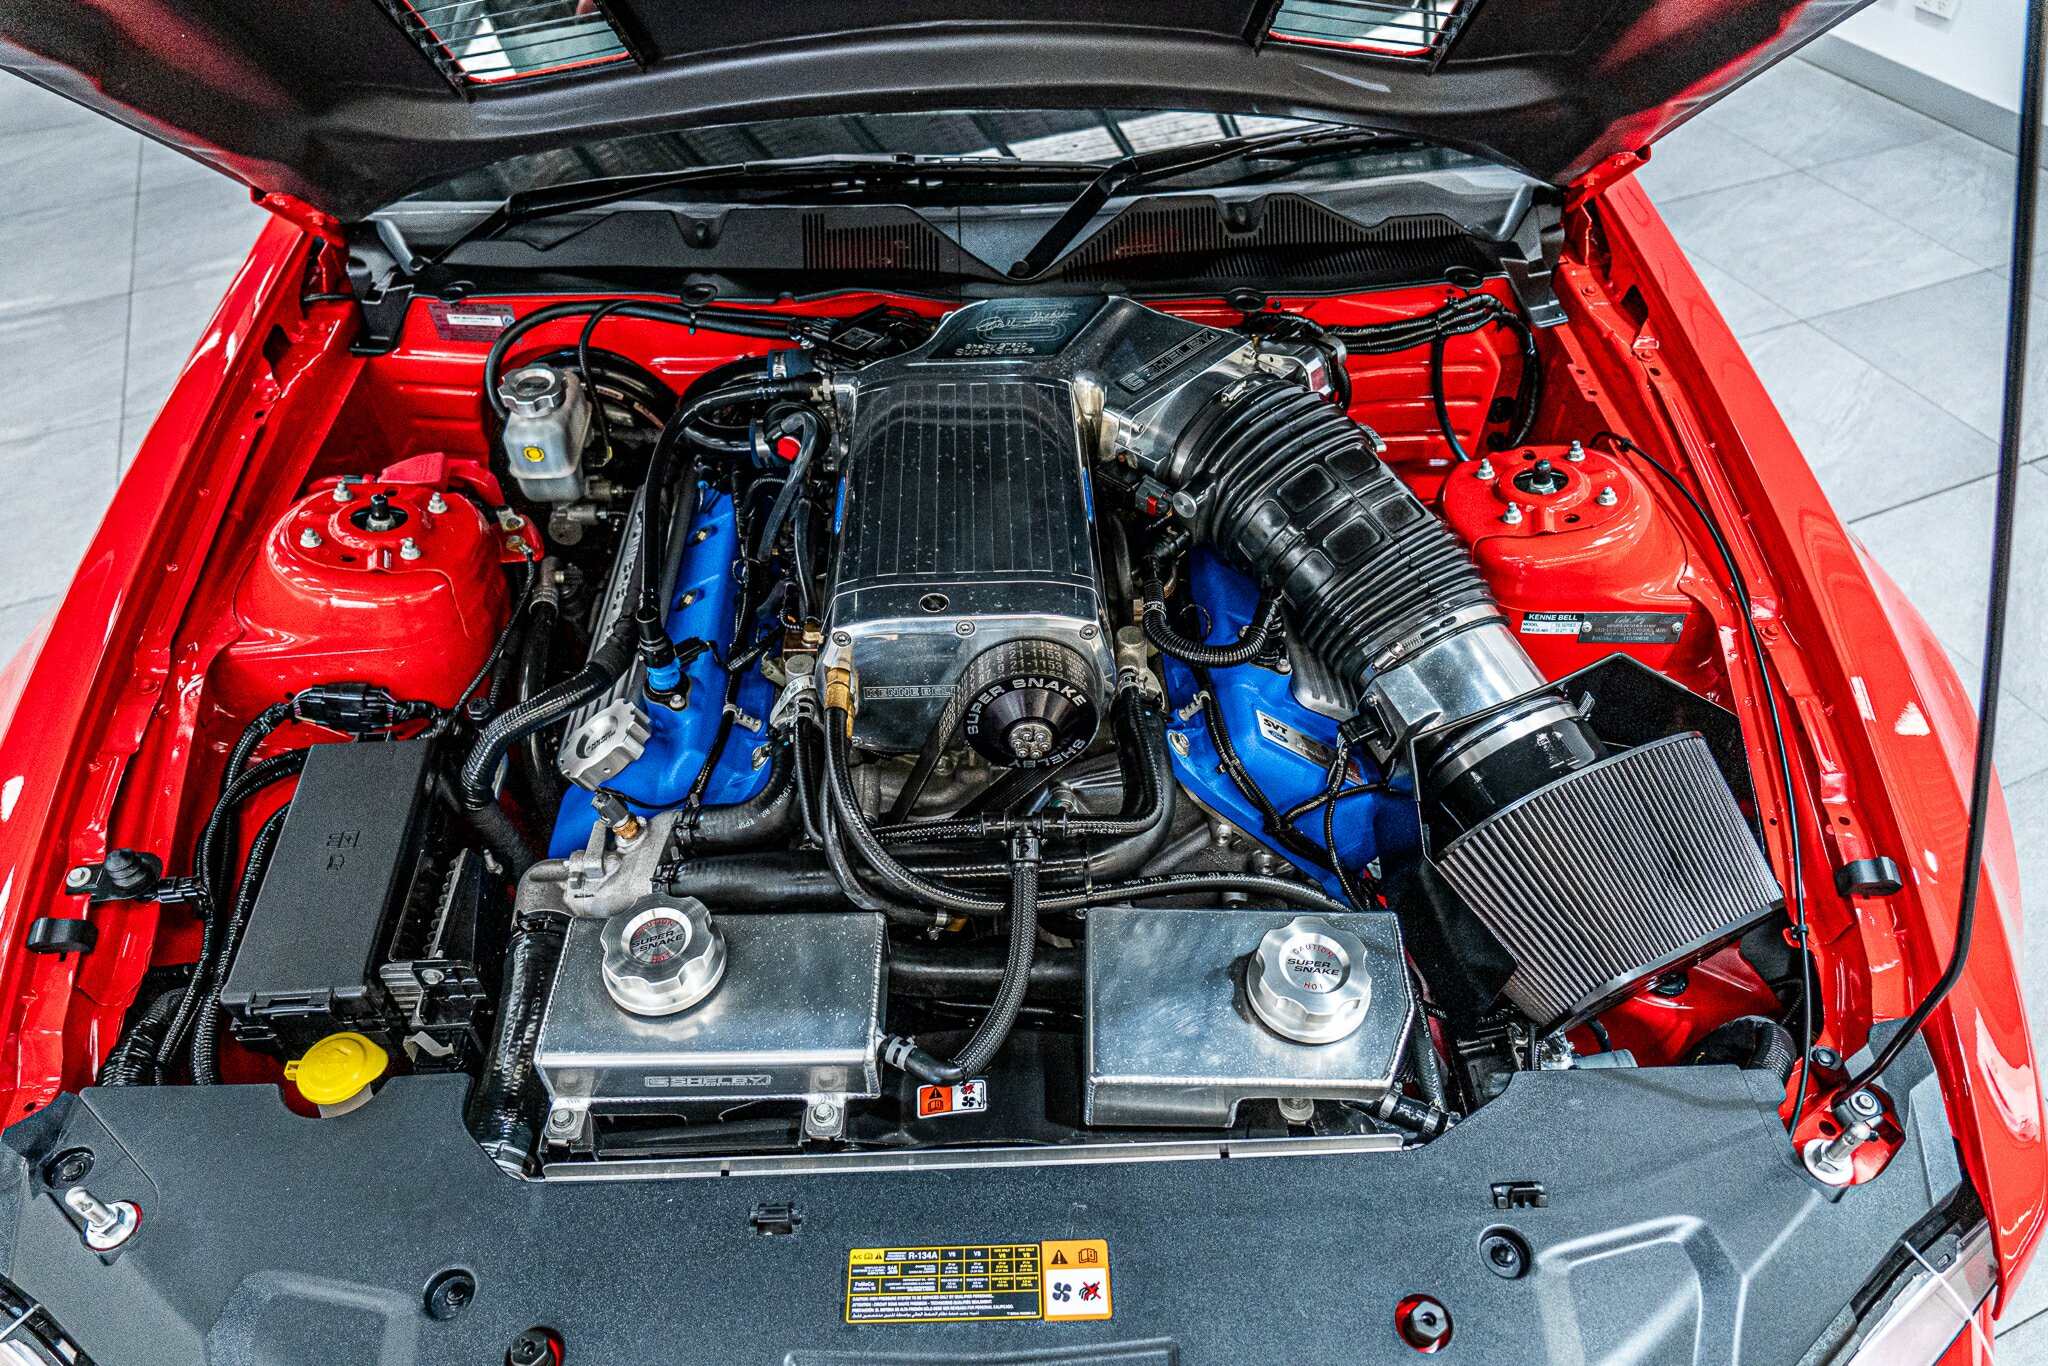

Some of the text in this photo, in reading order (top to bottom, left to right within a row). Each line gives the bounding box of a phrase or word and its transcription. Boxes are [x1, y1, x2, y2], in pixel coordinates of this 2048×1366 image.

[1009, 650, 1062, 661] 21-1153
[1009, 660, 1063, 671] 21-1153
[865, 687, 920, 698] KENNE
[966, 677, 1087, 735] SUPER SNAKE
[1263, 718, 1288, 734] SVT
[1009, 738, 1086, 768] SHELBY
[1124, 878, 1145, 886] USA
[634, 919, 675, 937] CAUTION
[632, 930, 675, 948] SUPER
[639, 933, 684, 952] SNAKE
[1292, 943, 1333, 958] CAUTION
[650, 951, 672, 963] HOT
[1287, 958, 1331, 968] SUPER
[1293, 965, 1340, 976] SNAKE
[671, 1076, 768, 1087] SHELBY
[908, 1250, 938, 1260] R-134A
